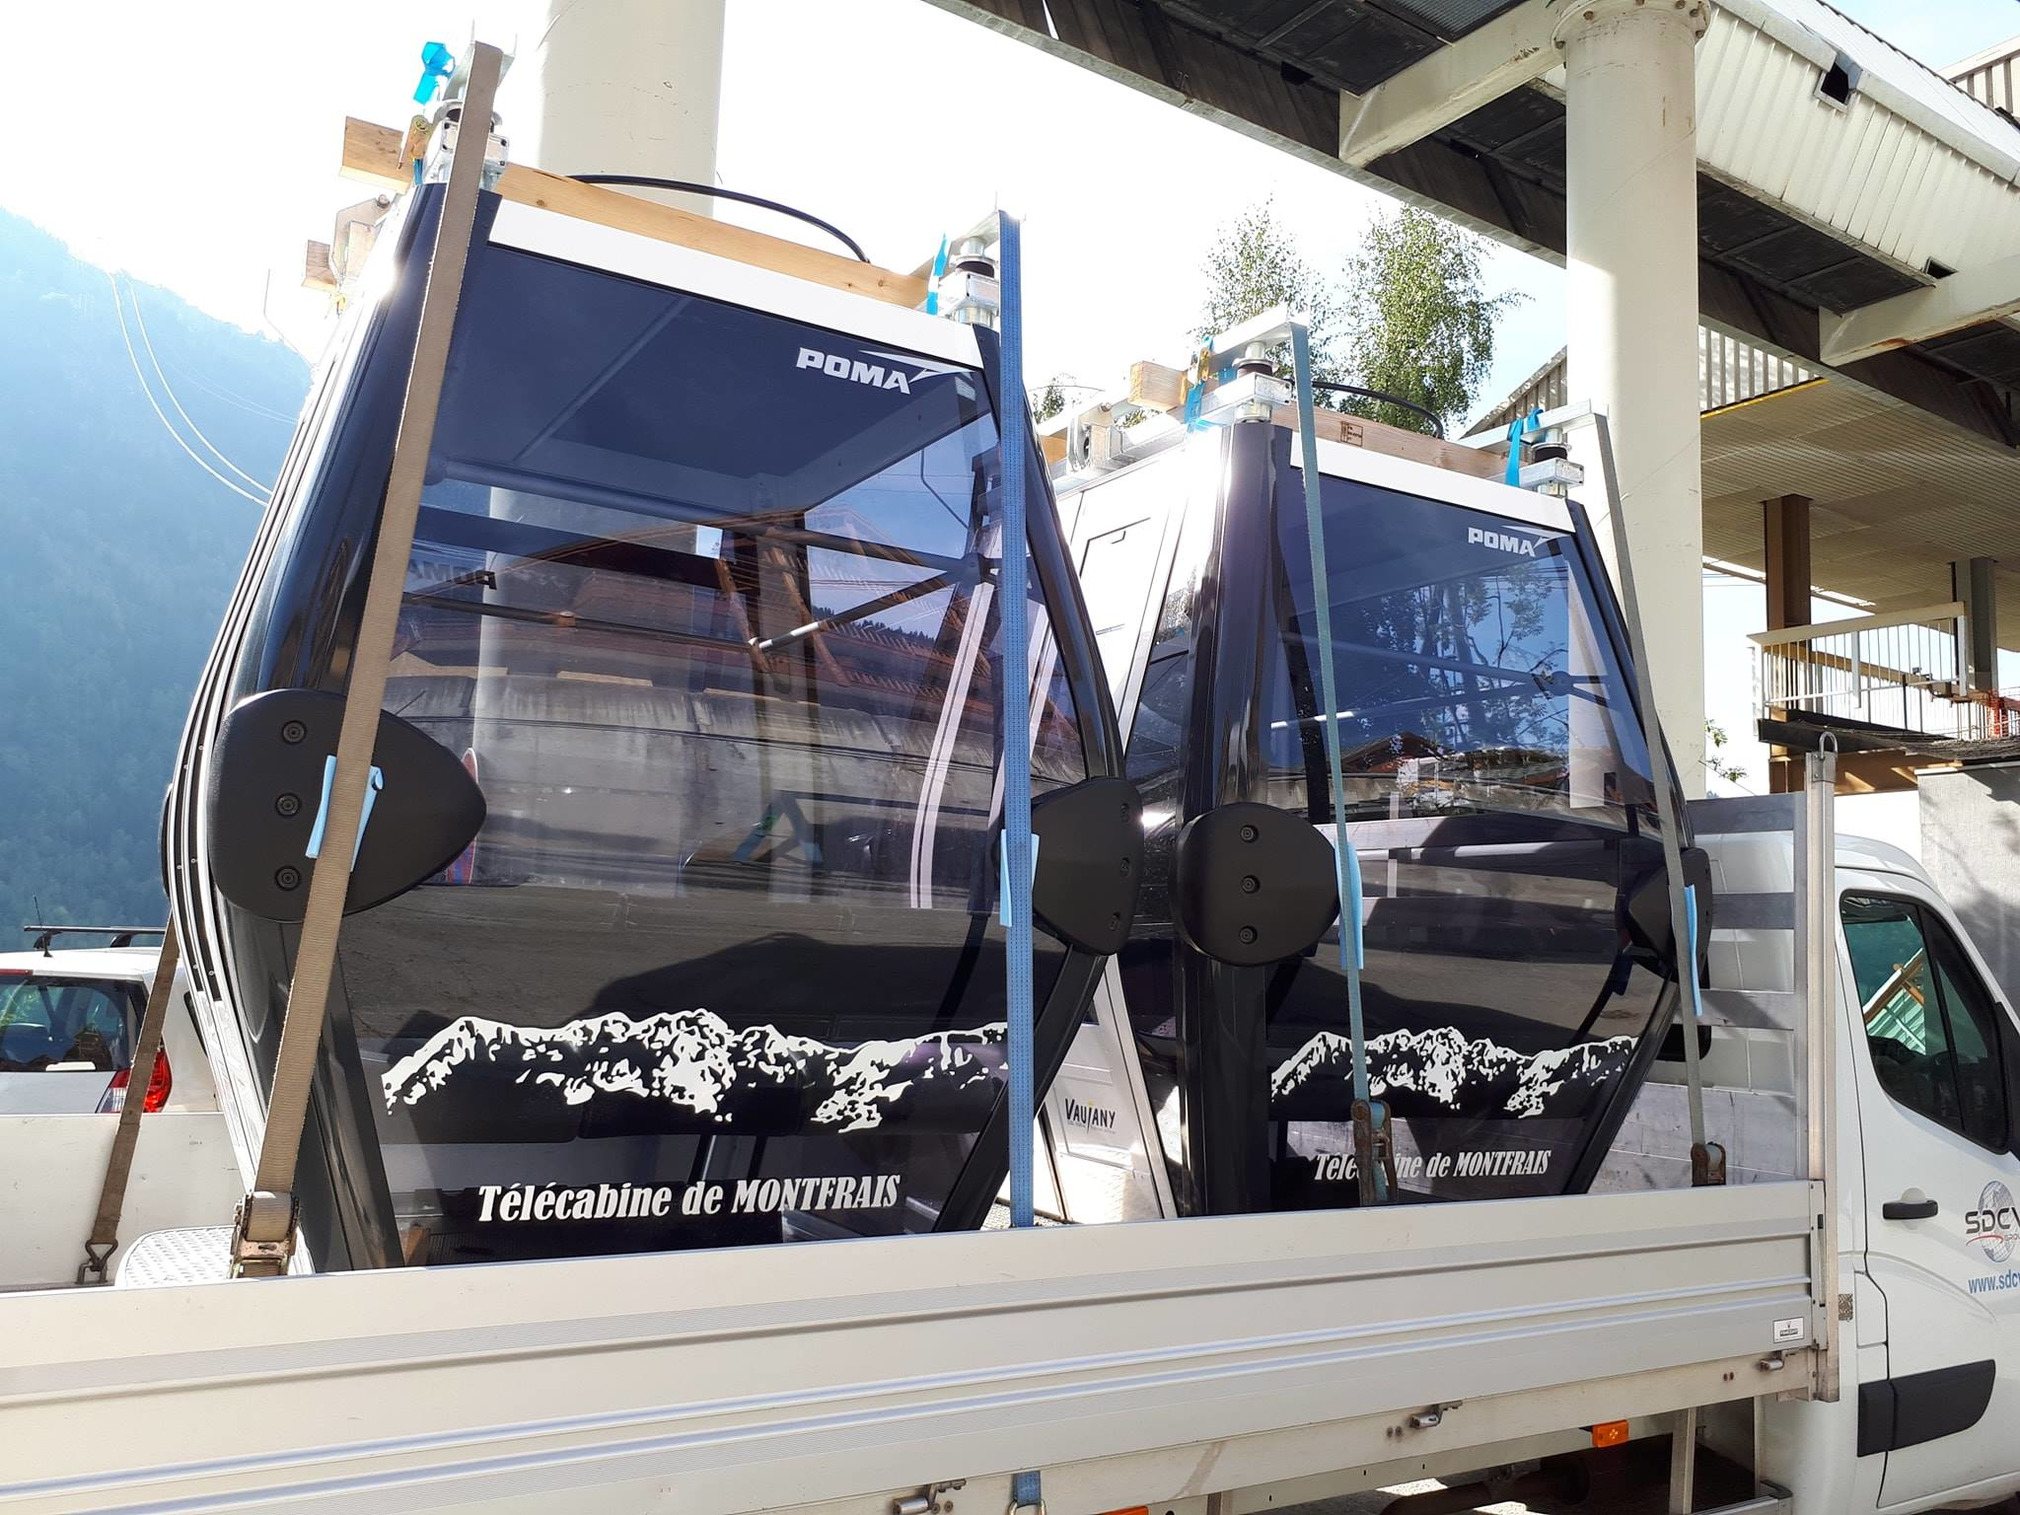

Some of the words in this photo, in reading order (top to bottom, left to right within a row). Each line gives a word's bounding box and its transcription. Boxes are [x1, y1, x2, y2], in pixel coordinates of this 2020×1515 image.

[796, 347, 911, 394] POMA
[1467, 527, 1536, 557] POMA
[1065, 1098, 1116, 1134] VAUJANY
[1426, 1152, 1451, 1178] de
[1453, 1150, 1552, 1177] MONTFRAIS
[478, 1182, 672, 1222] Télécabine
[681, 1181, 724, 1215] de
[731, 1174, 901, 1213] MONTFRAIS
[1968, 1269, 2020, 1294] www.sdc
